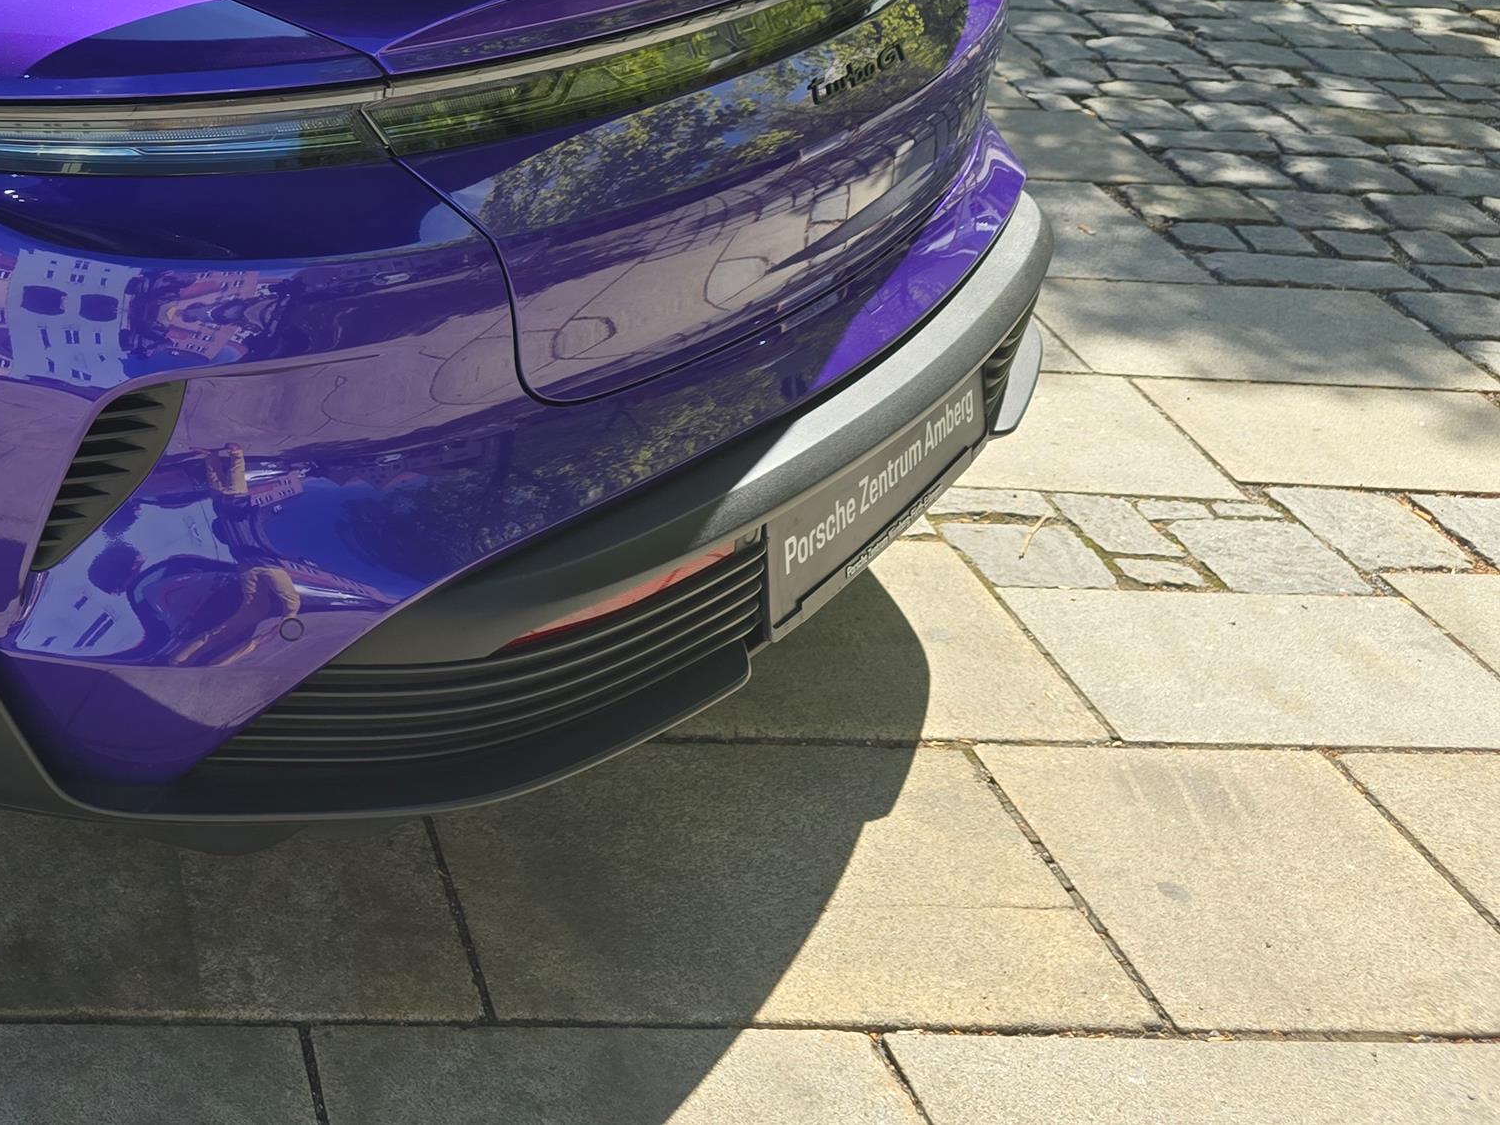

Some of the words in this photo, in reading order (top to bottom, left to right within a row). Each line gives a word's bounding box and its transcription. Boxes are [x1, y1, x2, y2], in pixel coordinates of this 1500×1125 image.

[784, 497, 856, 575] Porsche
[858, 436, 922, 515] Zentrum
[924, 389, 975, 457] Amberg
